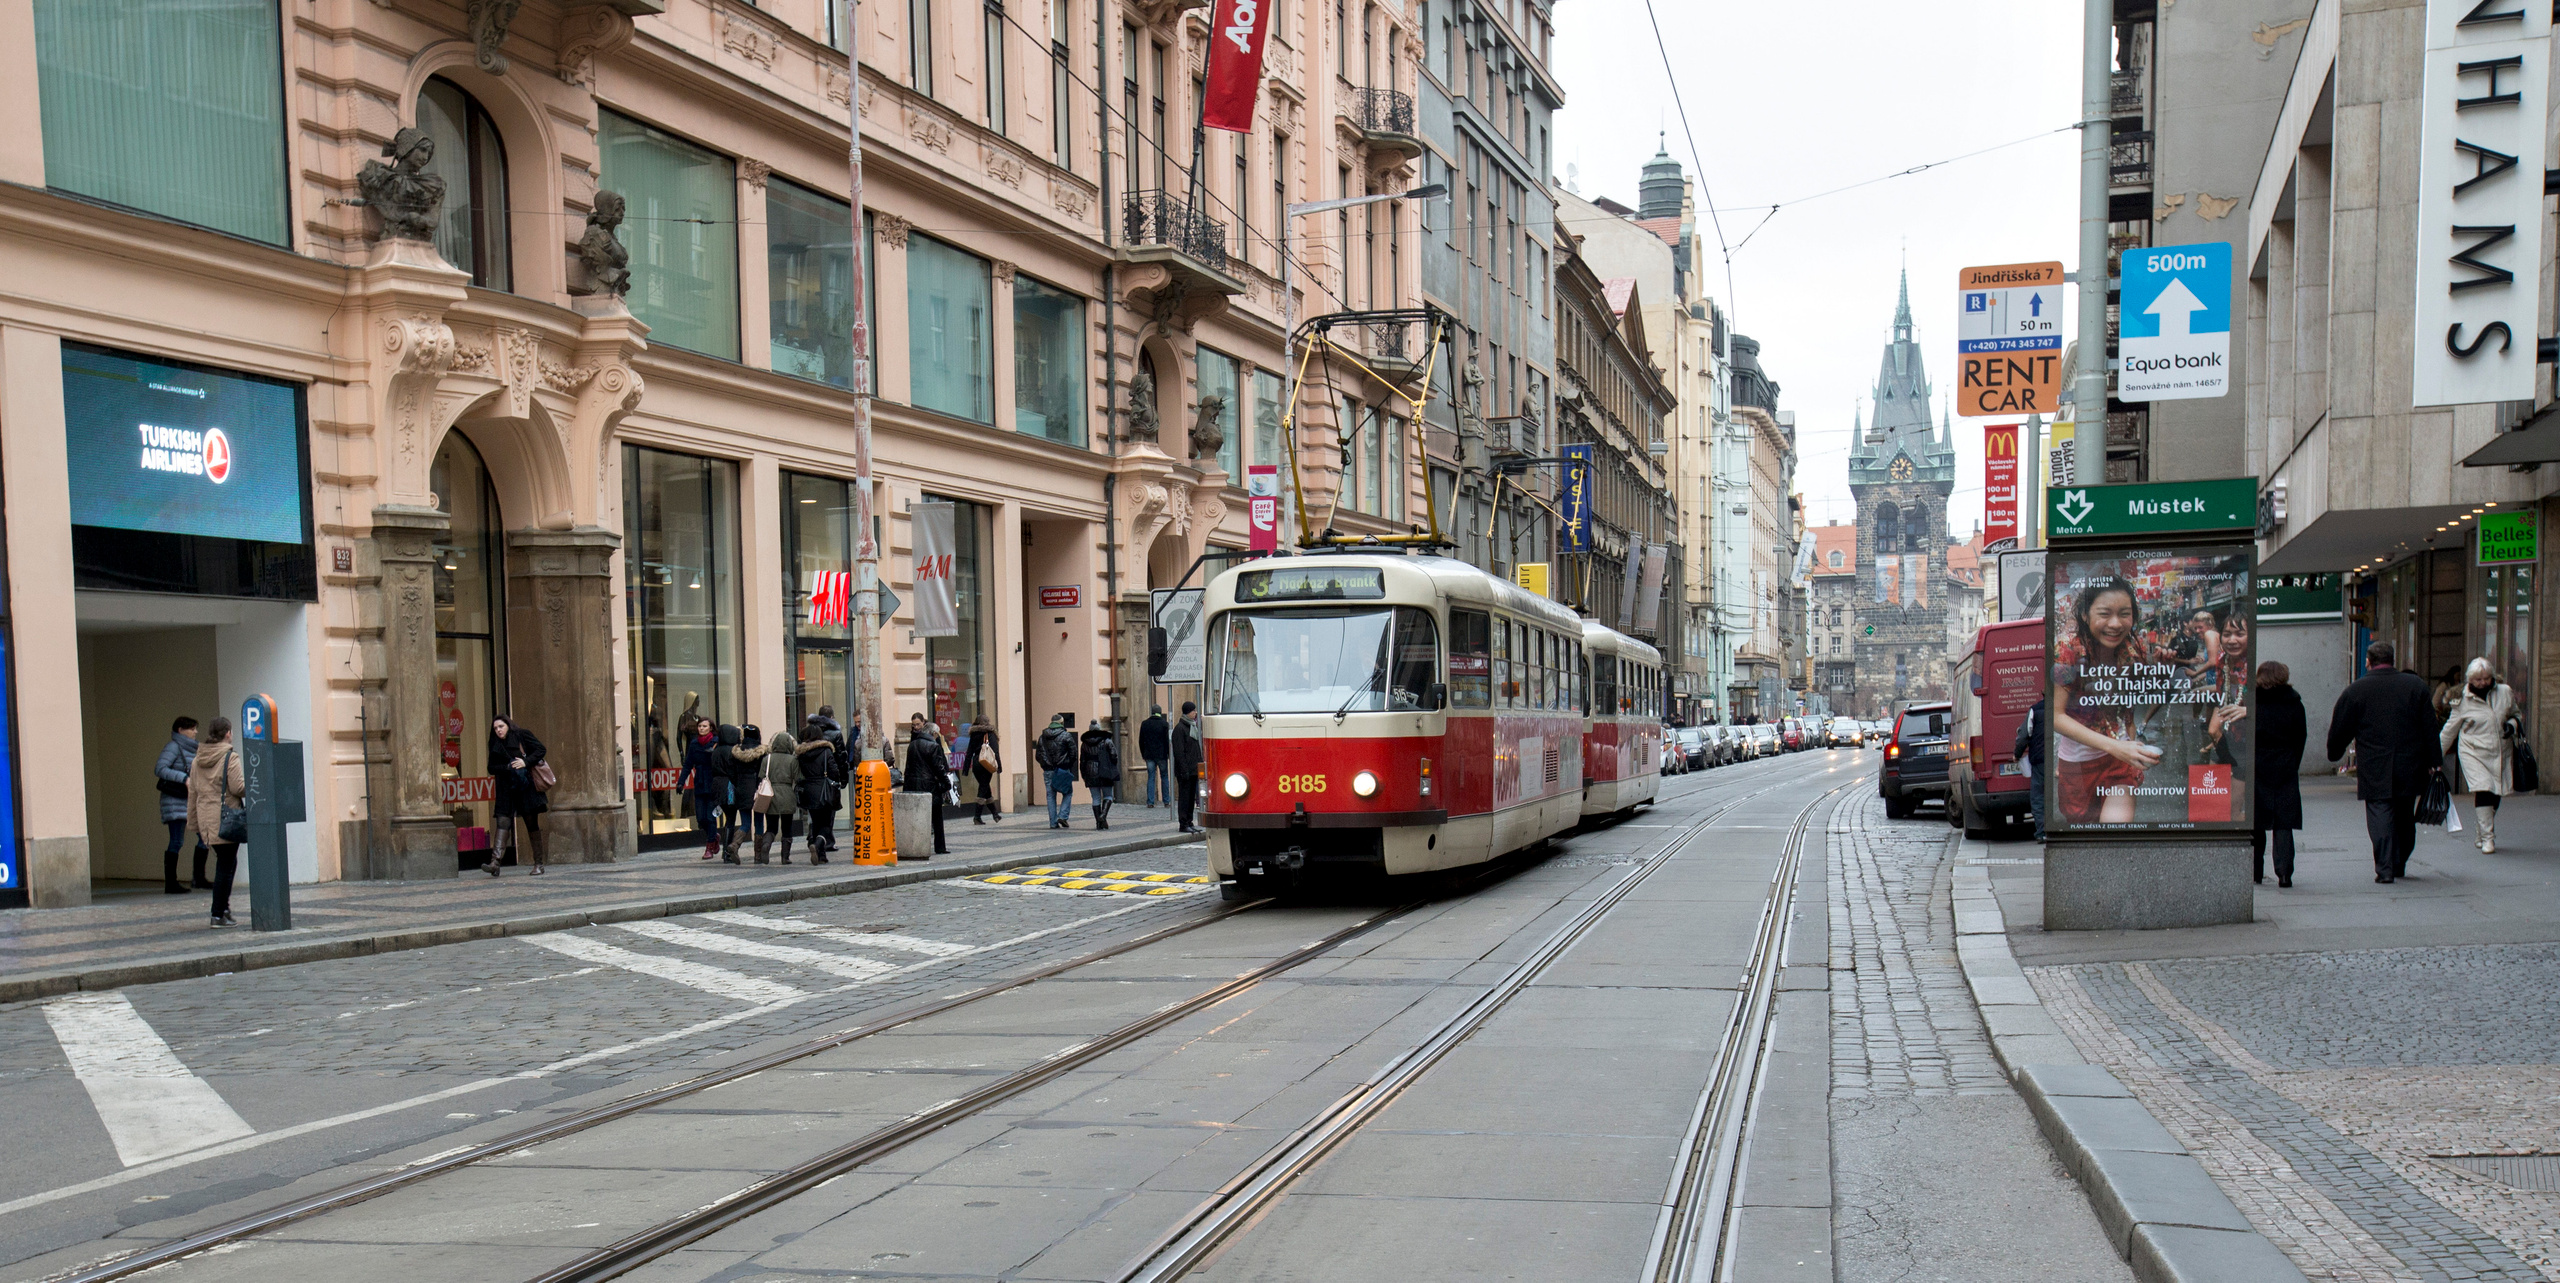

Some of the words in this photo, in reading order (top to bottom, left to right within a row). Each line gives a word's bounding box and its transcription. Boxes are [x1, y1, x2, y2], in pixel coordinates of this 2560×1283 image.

[2147, 254, 2206, 272] 500m
[1971, 269, 2040, 284] Jindřišská
[2046, 268, 2053, 280] 7
[2020, 320, 2035, 330] 50
[1969, 342, 1998, 352] (+420)
[2000, 341, 2016, 349] 774
[2126, 356, 2170, 374] Equa
[2175, 352, 2222, 368] bank
[1964, 356, 2056, 387] RENT
[2126, 382, 2170, 391] Senovážné
[2195, 379, 2222, 387] 1465/7
[1979, 389, 2036, 412] CAR
[139, 424, 201, 453] TURKISH
[141, 448, 203, 475] AIRLINES
[2129, 497, 2205, 515] Můstek
[2056, 526, 2083, 534] Metro
[2481, 527, 2534, 542] Belles
[336, 550, 350, 560] 832
[2126, 551, 2172, 559] JCDecaux
[2481, 545, 2534, 559] Fleurs
[916, 554, 952, 581] H&M
[2006, 556, 2030, 568] PĚŠÍ
[1252, 573, 1269, 596] 3
[2179, 572, 2232, 581] emirates.com/cz
[810, 570, 850, 629] H&M
[1180, 593, 1198, 604] ZÓN
[1997, 665, 2039, 675] VINOTÉKA
[2080, 664, 2117, 677] Leťte
[2121, 666, 2129, 676] z
[2134, 662, 2176, 678] Prahy
[2095, 678, 2112, 691] do
[2116, 677, 2170, 693] Thajska
[2174, 679, 2191, 689] za
[1394, 688, 1407, 701] 515
[2079, 691, 2166, 708] osvěžujícími
[2170, 690, 2225, 706] zážitky
[247, 707, 260, 730] P
[854, 774, 863, 809] CAR
[1278, 774, 1326, 793] 8185
[2096, 786, 2125, 796] Hello
[2128, 786, 2186, 796] Tomorrow
[2192, 786, 2228, 795] Emirates
[864, 775, 873, 823] SCOOTER
[854, 817, 862, 859] RENT
